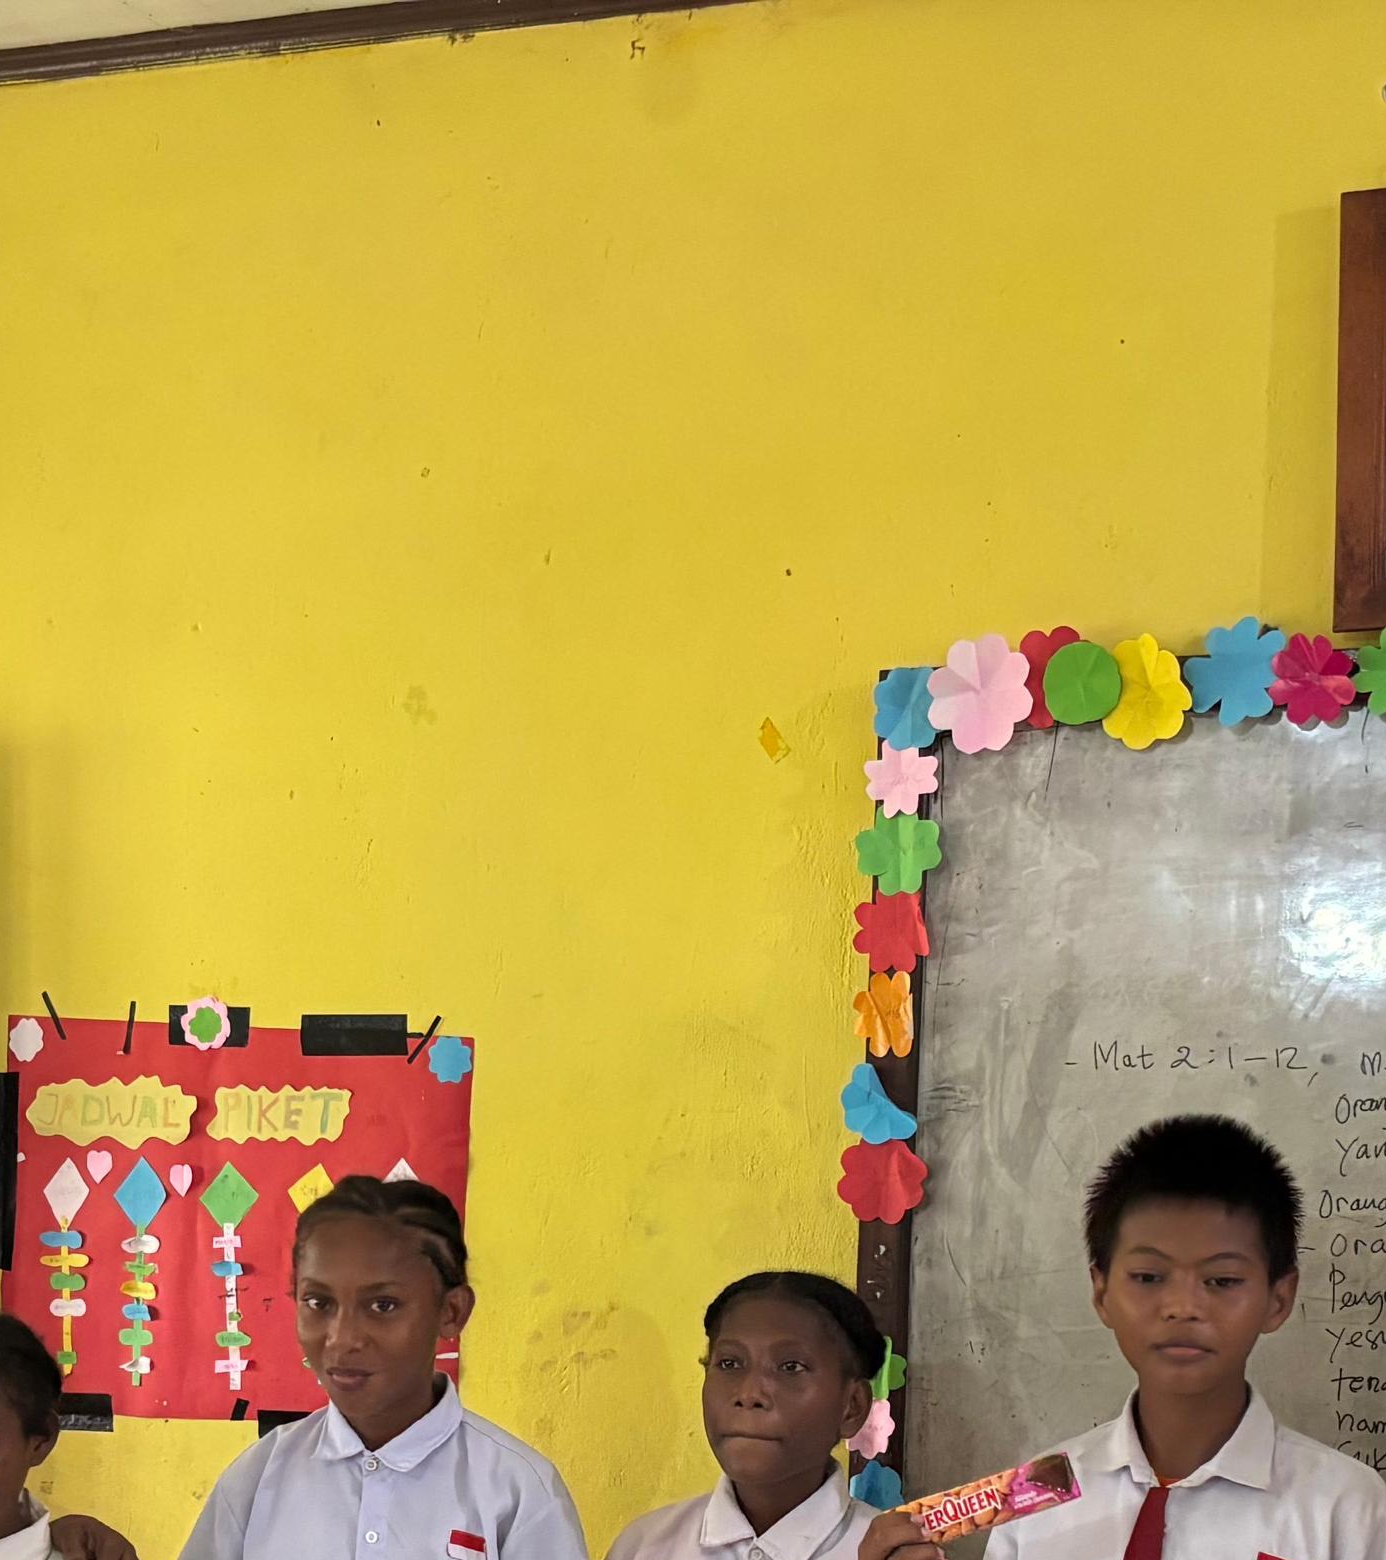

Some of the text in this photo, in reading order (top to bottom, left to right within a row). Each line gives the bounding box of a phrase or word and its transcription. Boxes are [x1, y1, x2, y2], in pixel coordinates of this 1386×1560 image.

[1093, 1041, 1156, 1071] Mat
[36, 1091, 343, 1134] JADWAL PIKET
[924, 1487, 1001, 1532] ERQUEEN
